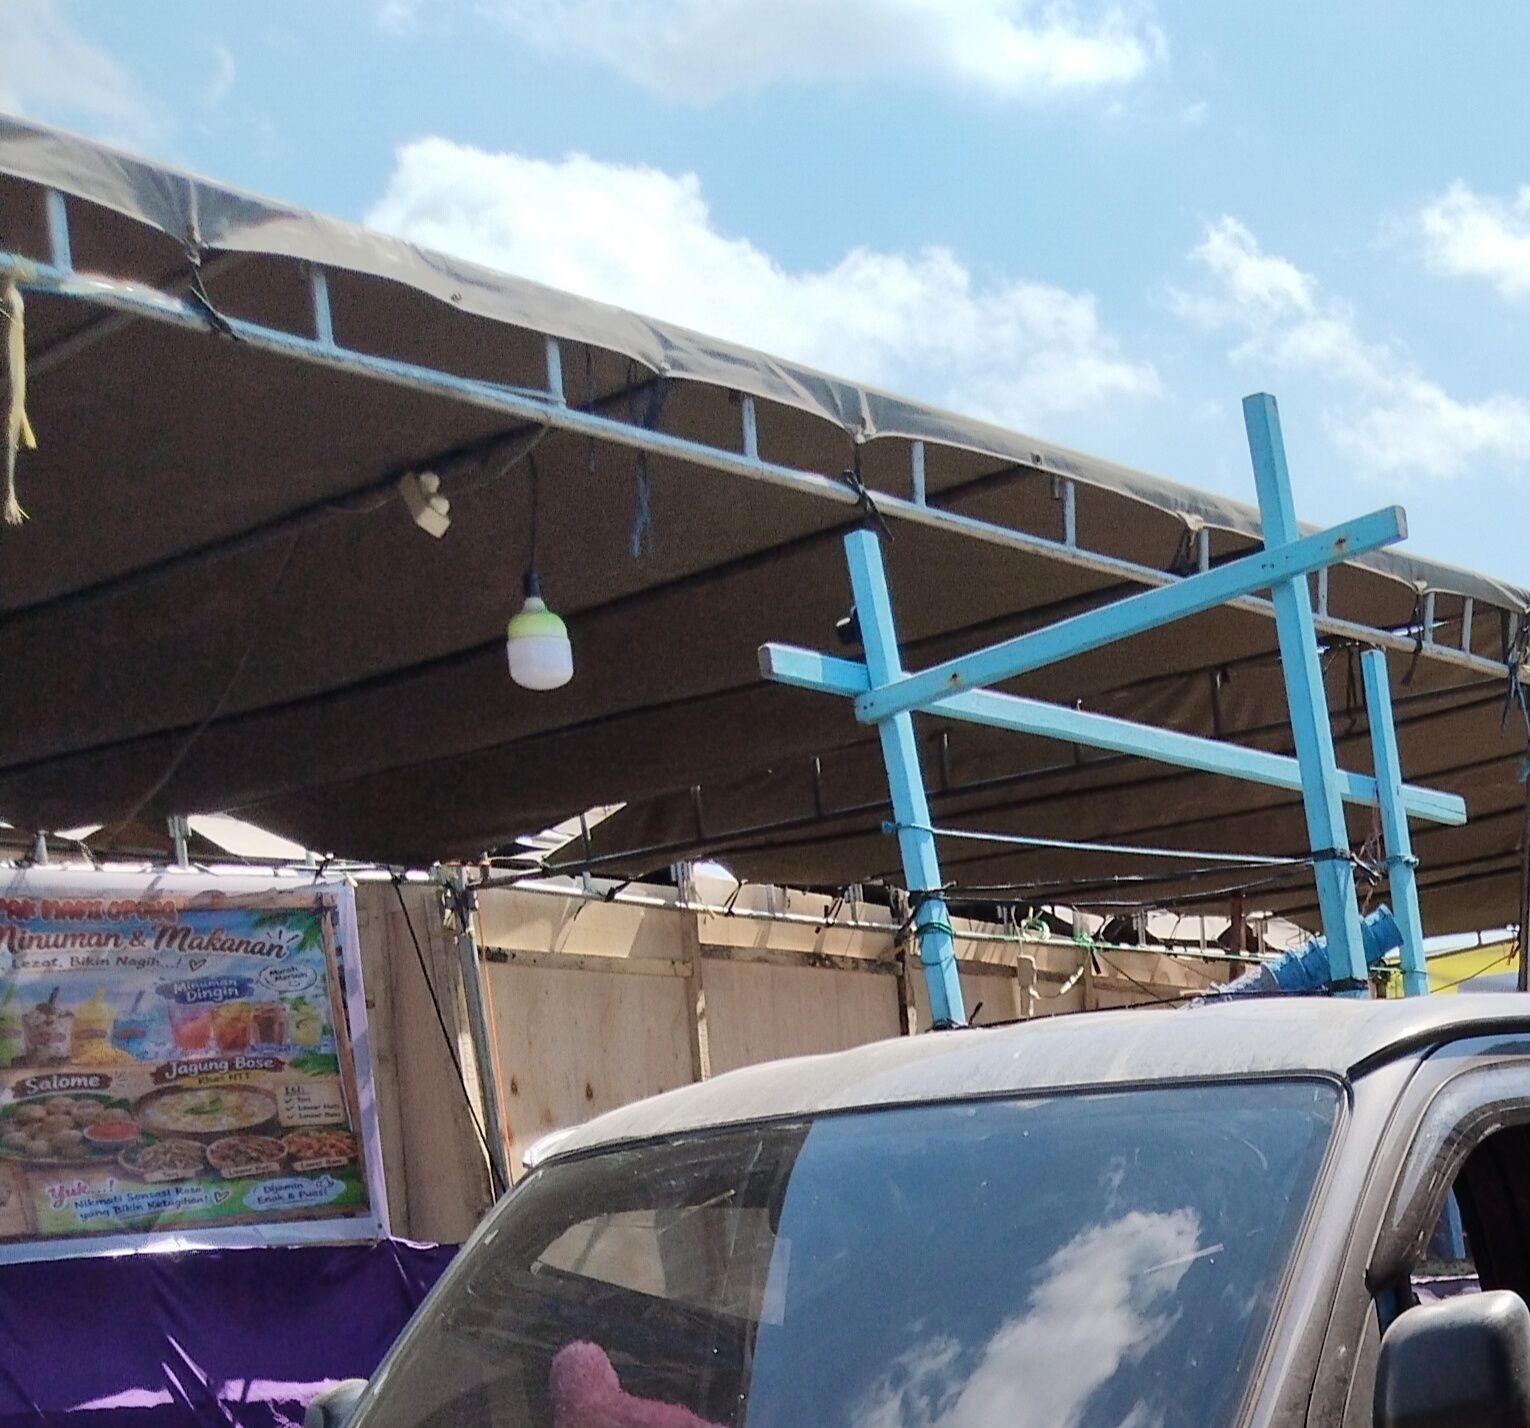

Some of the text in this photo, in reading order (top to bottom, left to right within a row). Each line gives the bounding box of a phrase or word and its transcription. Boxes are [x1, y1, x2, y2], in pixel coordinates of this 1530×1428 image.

[129, 929, 147, 948] &
[152, 924, 288, 959] Makanan
[70, 955, 110, 967] Bikin
[173, 979, 238, 994] Minuman
[186, 986, 239, 1002] Dingin
[165, 1056, 274, 1079] Jagung Bose
[25, 1074, 101, 1094] Salome
[263, 1182, 304, 1194] Dijamin
[257, 1194, 285, 1204] Enak
[80, 1209, 110, 1222] yang
[114, 1204, 144, 1214] Bikin
